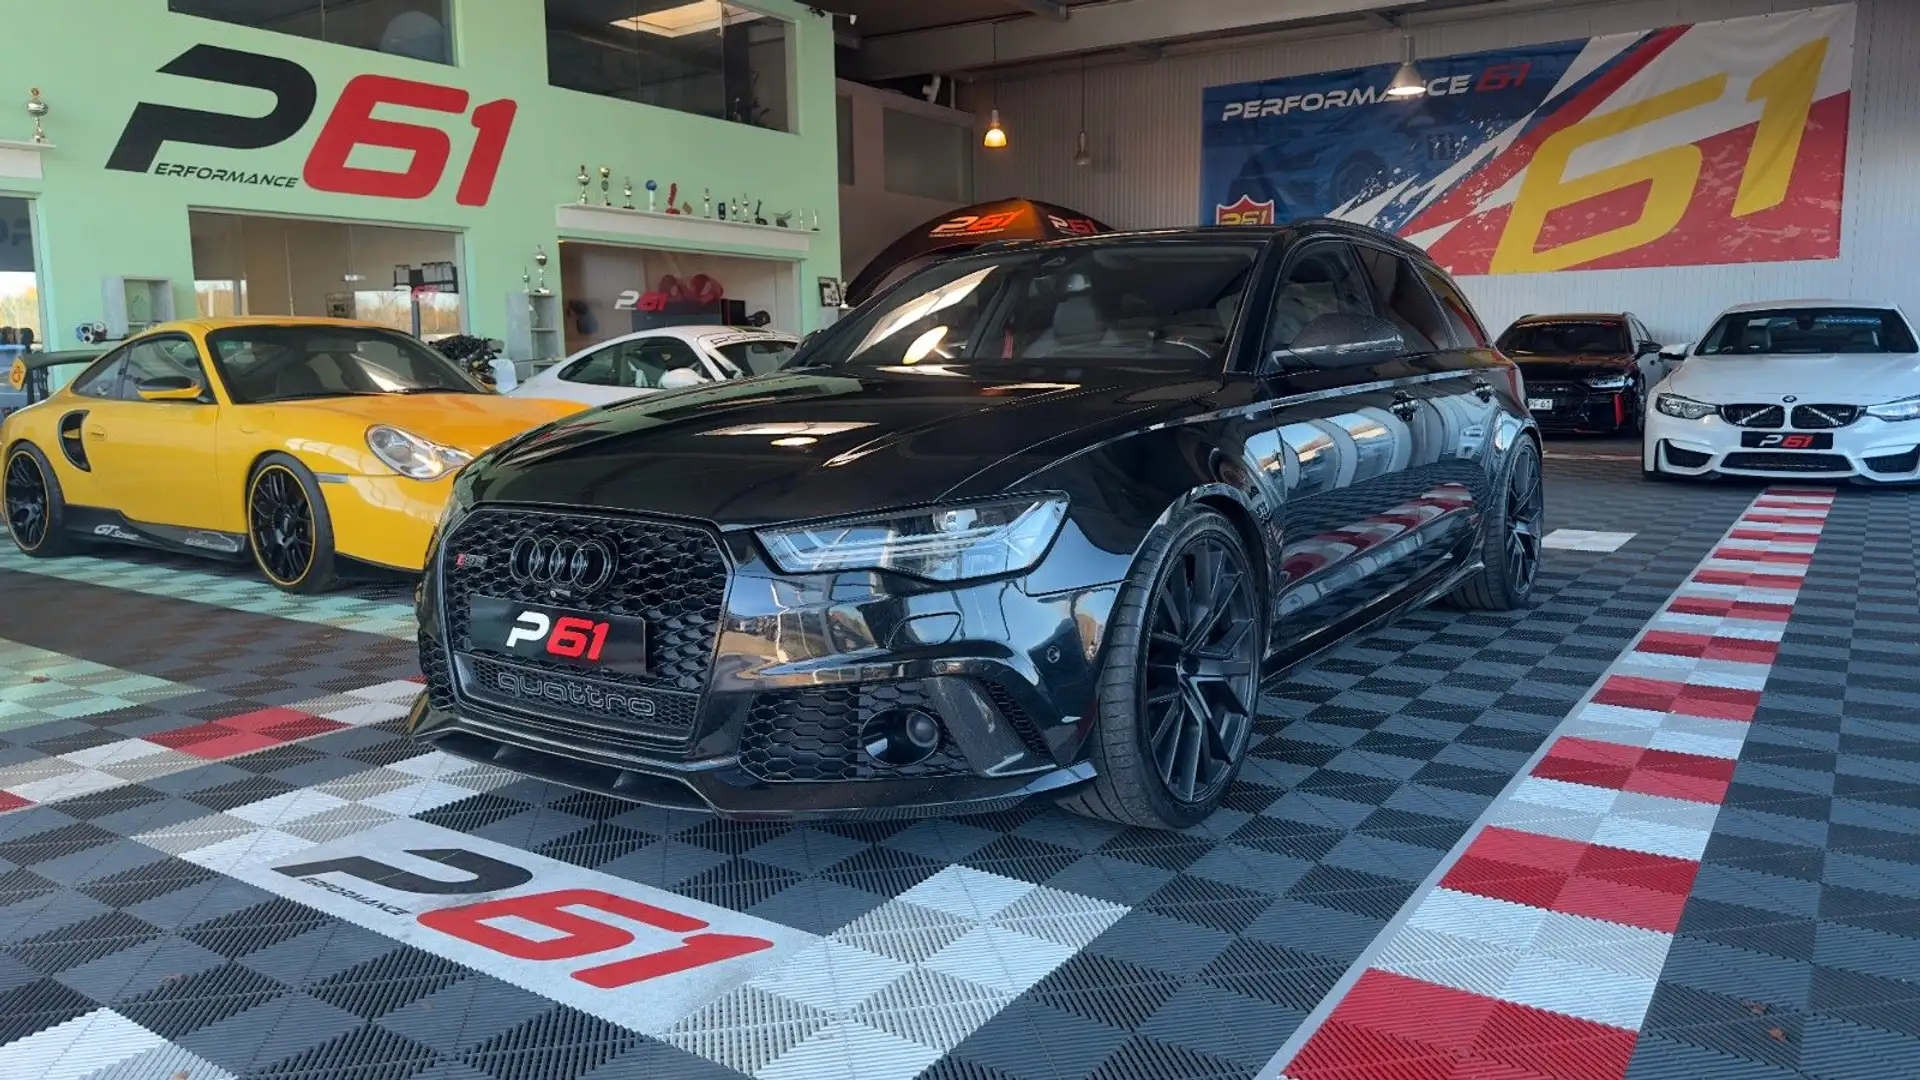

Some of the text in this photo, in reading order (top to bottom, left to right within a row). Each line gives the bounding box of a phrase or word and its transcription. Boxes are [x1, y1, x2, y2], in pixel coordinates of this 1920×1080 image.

[1475, 62, 1532, 93] 61
[104, 43, 518, 207] P61
[1489, 35, 1830, 276] 61
[1759, 434, 1814, 448] P61
[94, 524, 120, 535] GT
[506, 610, 610, 661] P61
[498, 671, 656, 717] quattro
